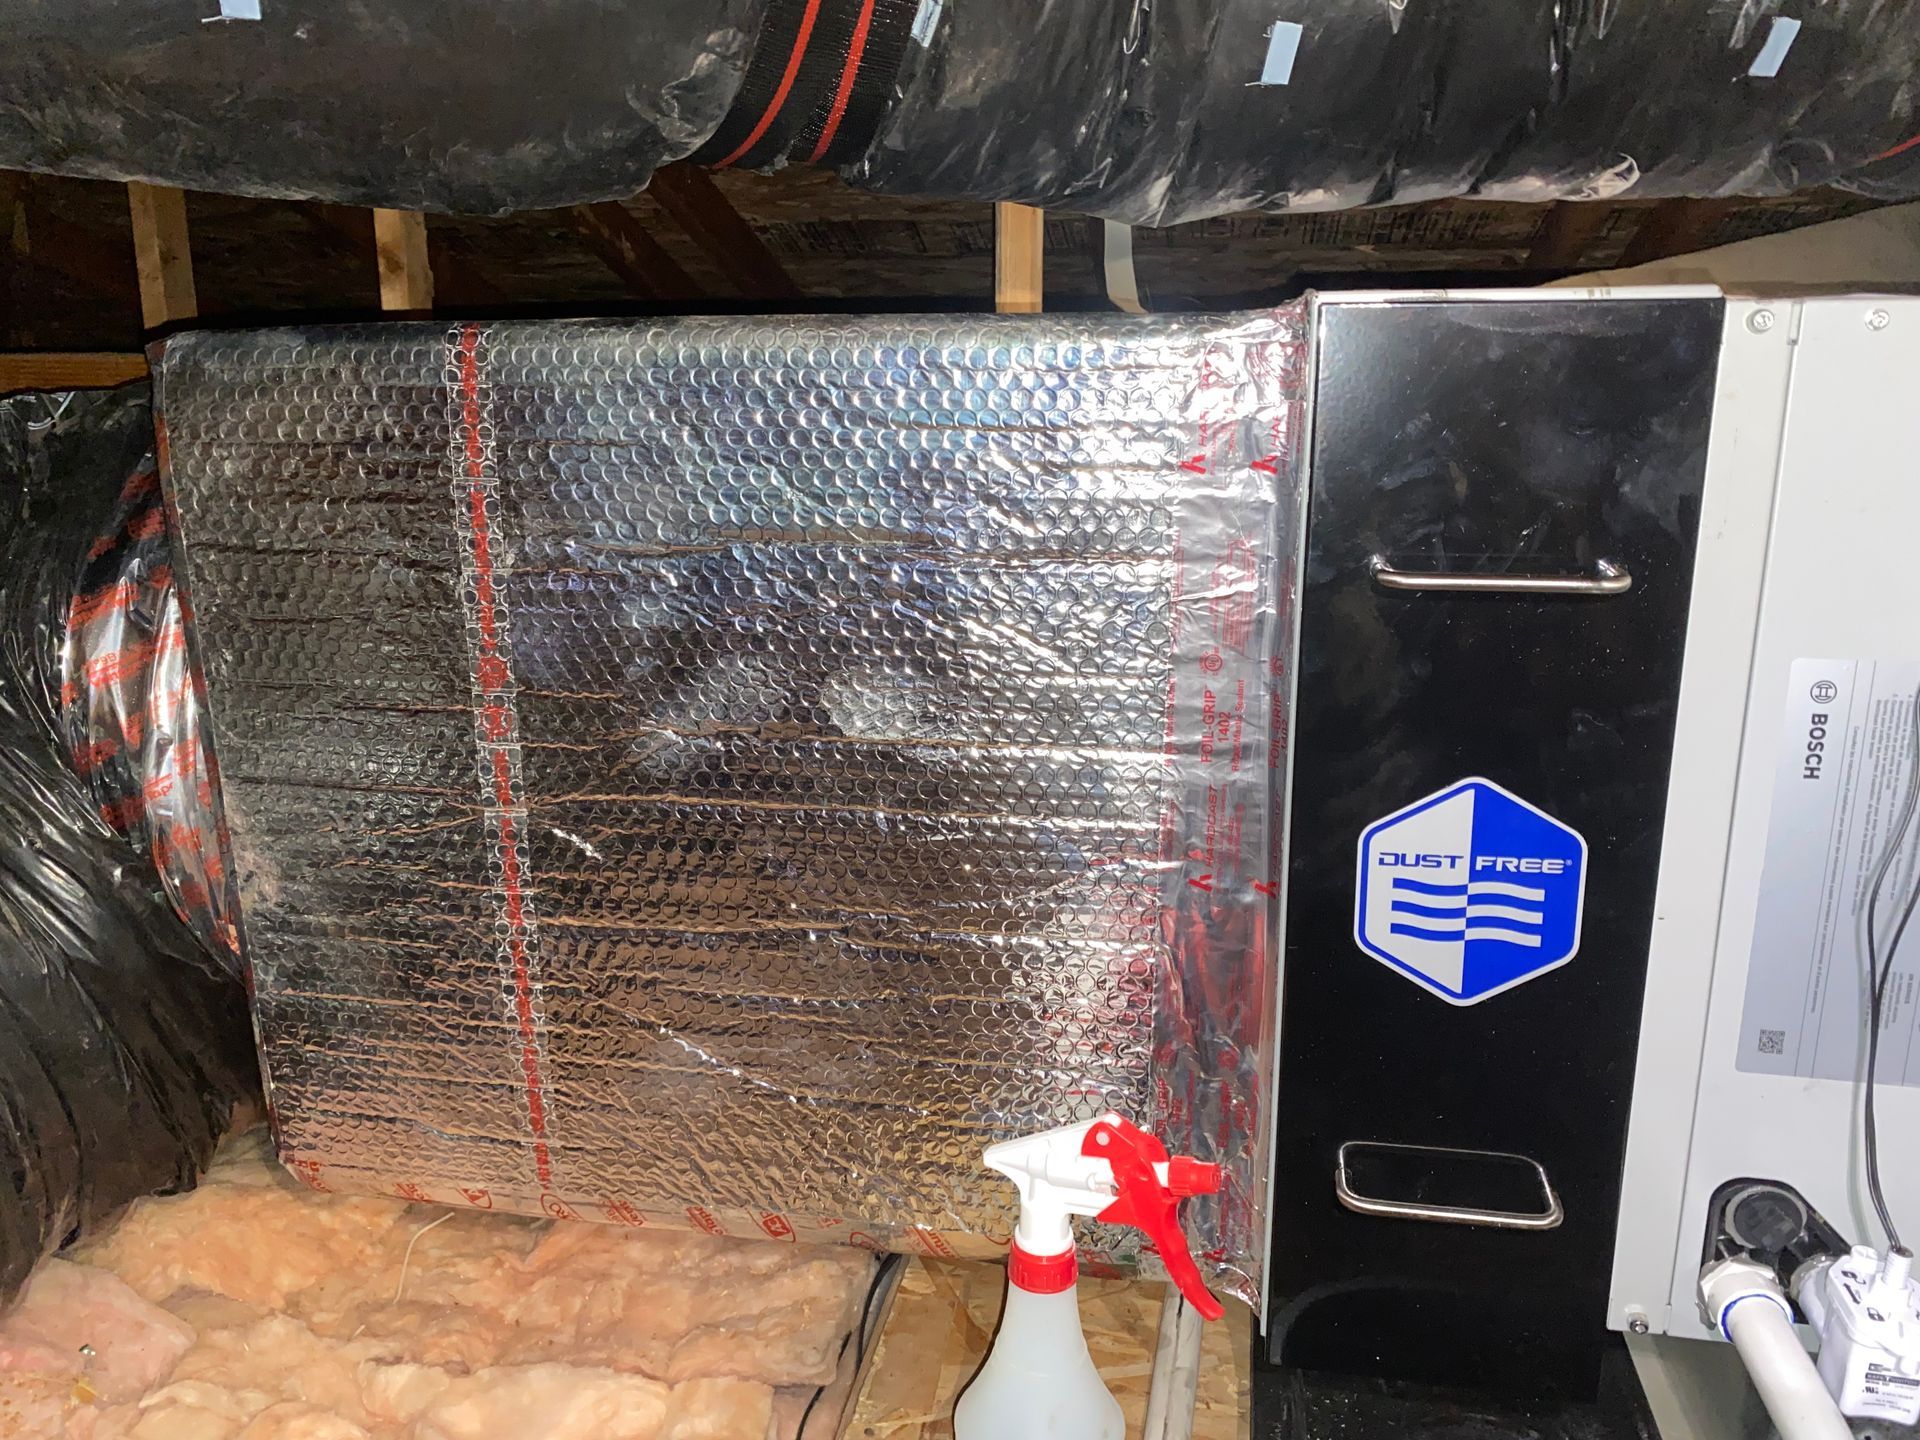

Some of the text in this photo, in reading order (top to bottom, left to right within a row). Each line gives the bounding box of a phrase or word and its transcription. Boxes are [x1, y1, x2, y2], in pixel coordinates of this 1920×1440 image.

[1234, 679, 1246, 711] Sealant
[1200, 690, 1217, 763] FOIL-GRIP
[1219, 711, 1231, 743] 1402
[1803, 714, 1828, 779] BOSCH
[1205, 785, 1218, 869] HARDCAST
[1378, 852, 1464, 868] DUST
